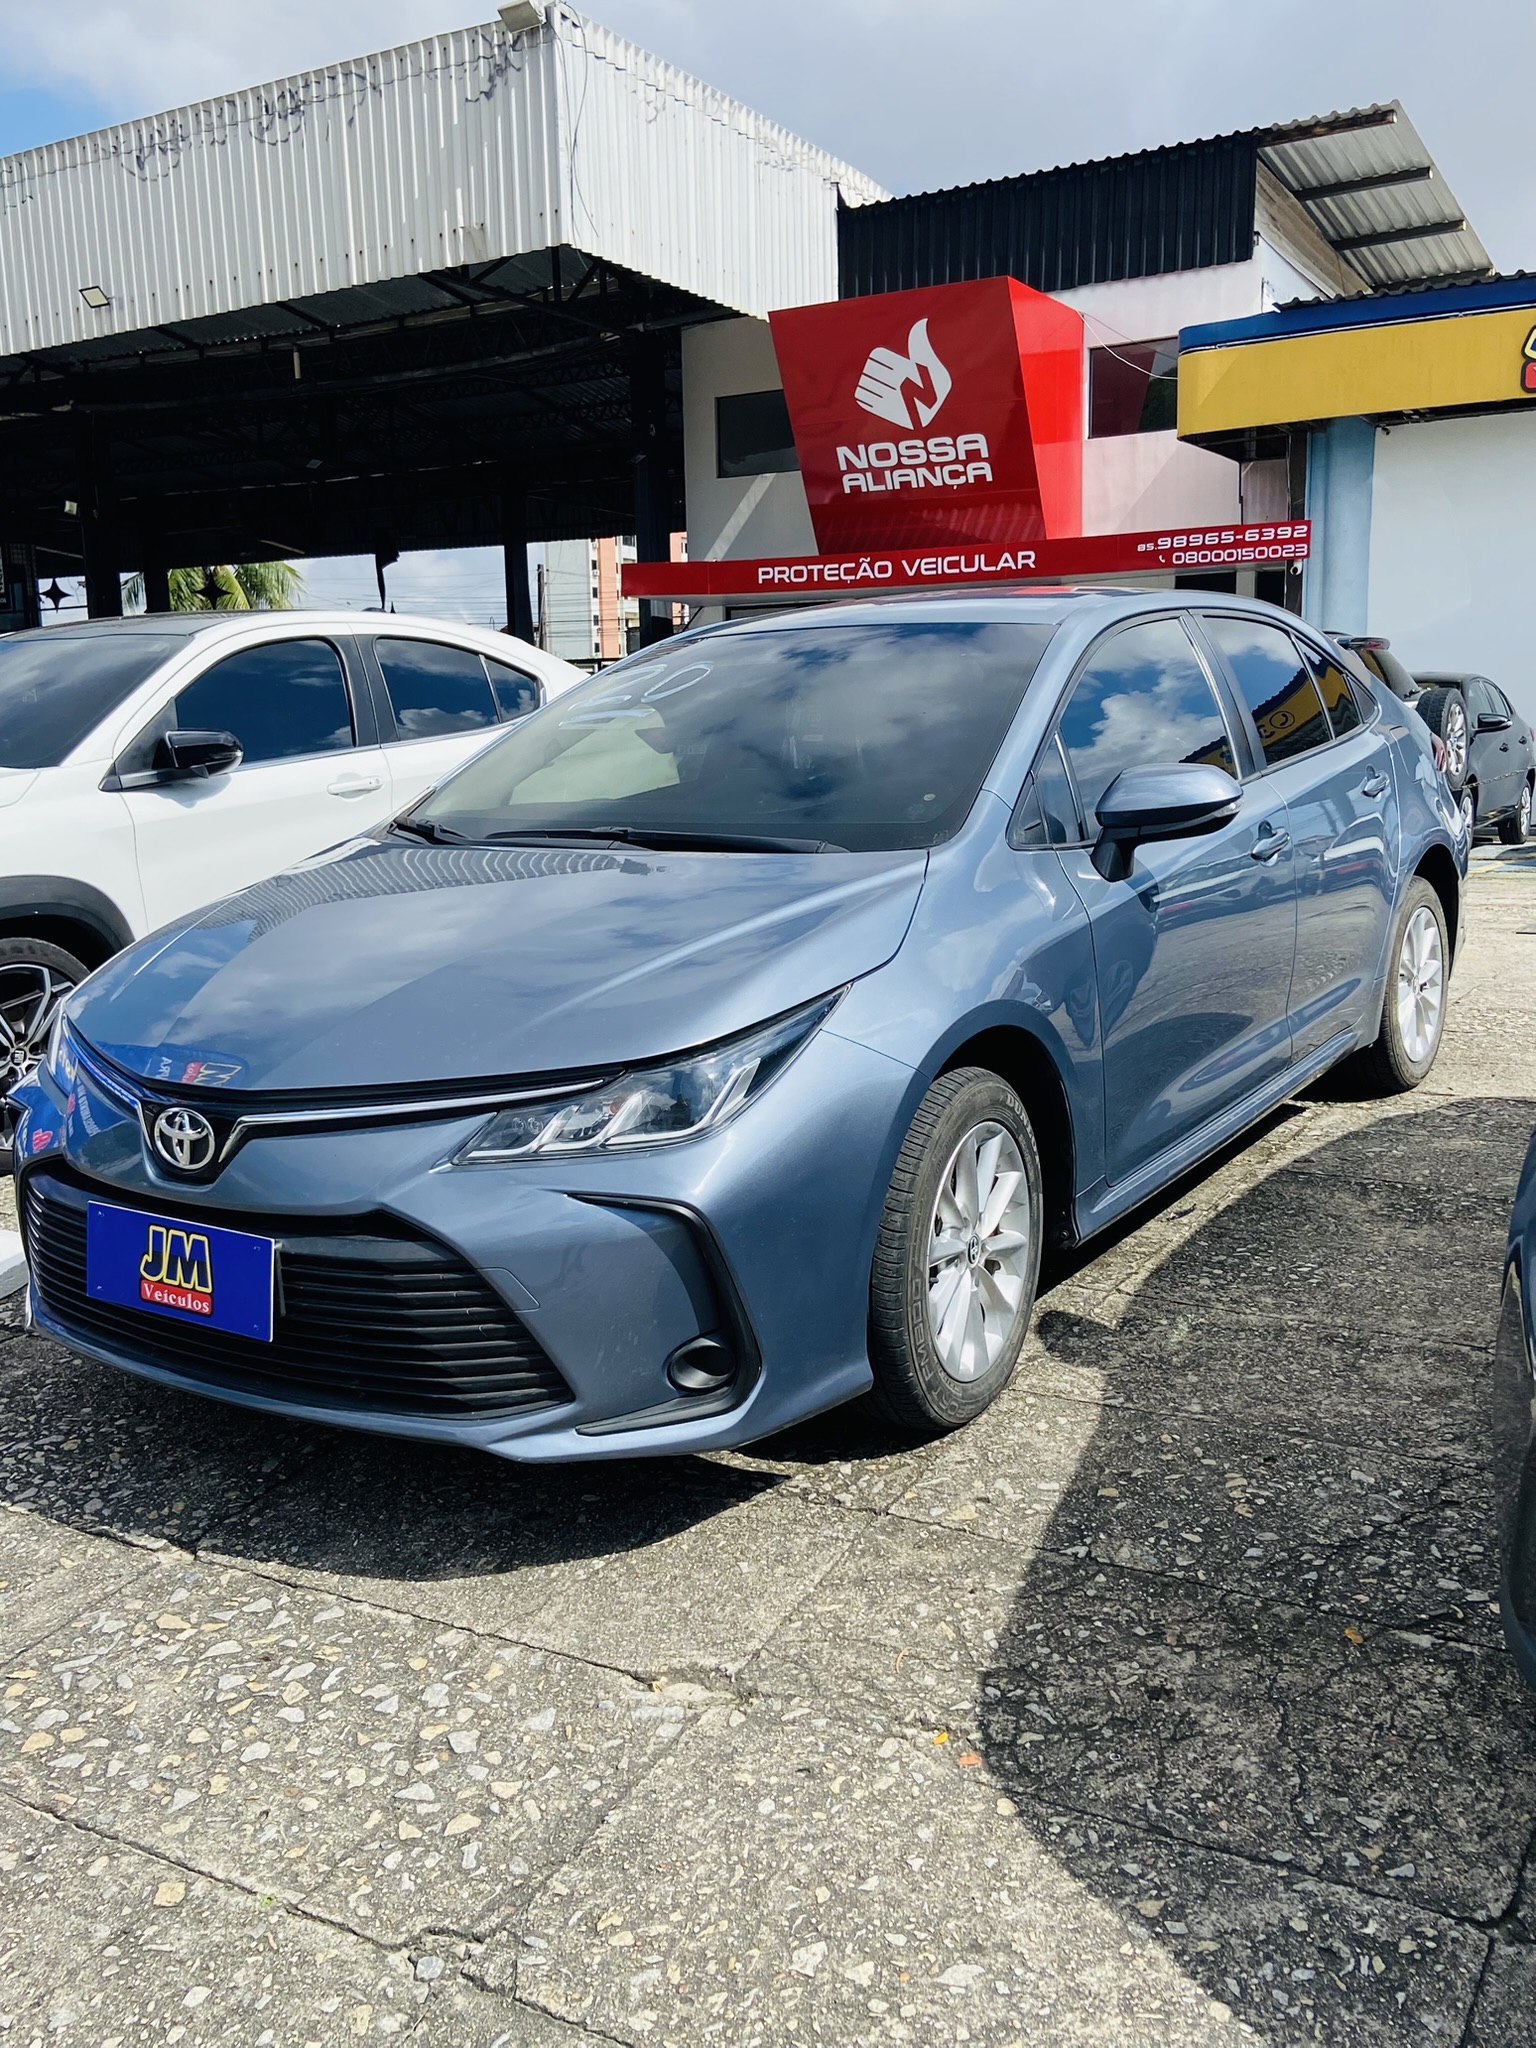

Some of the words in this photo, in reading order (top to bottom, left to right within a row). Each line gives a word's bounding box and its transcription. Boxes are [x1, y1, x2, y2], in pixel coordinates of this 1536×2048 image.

[835, 433, 990, 471] NOSSA
[842, 461, 993, 494] ALIANÇA
[758, 557, 893, 584] PROTEÇÃO
[902, 550, 1036, 577] VEICULAR
[1172, 543, 1309, 565] 08000150023
[140, 1225, 212, 1293] JM
[143, 1283, 210, 1313] Veículos
